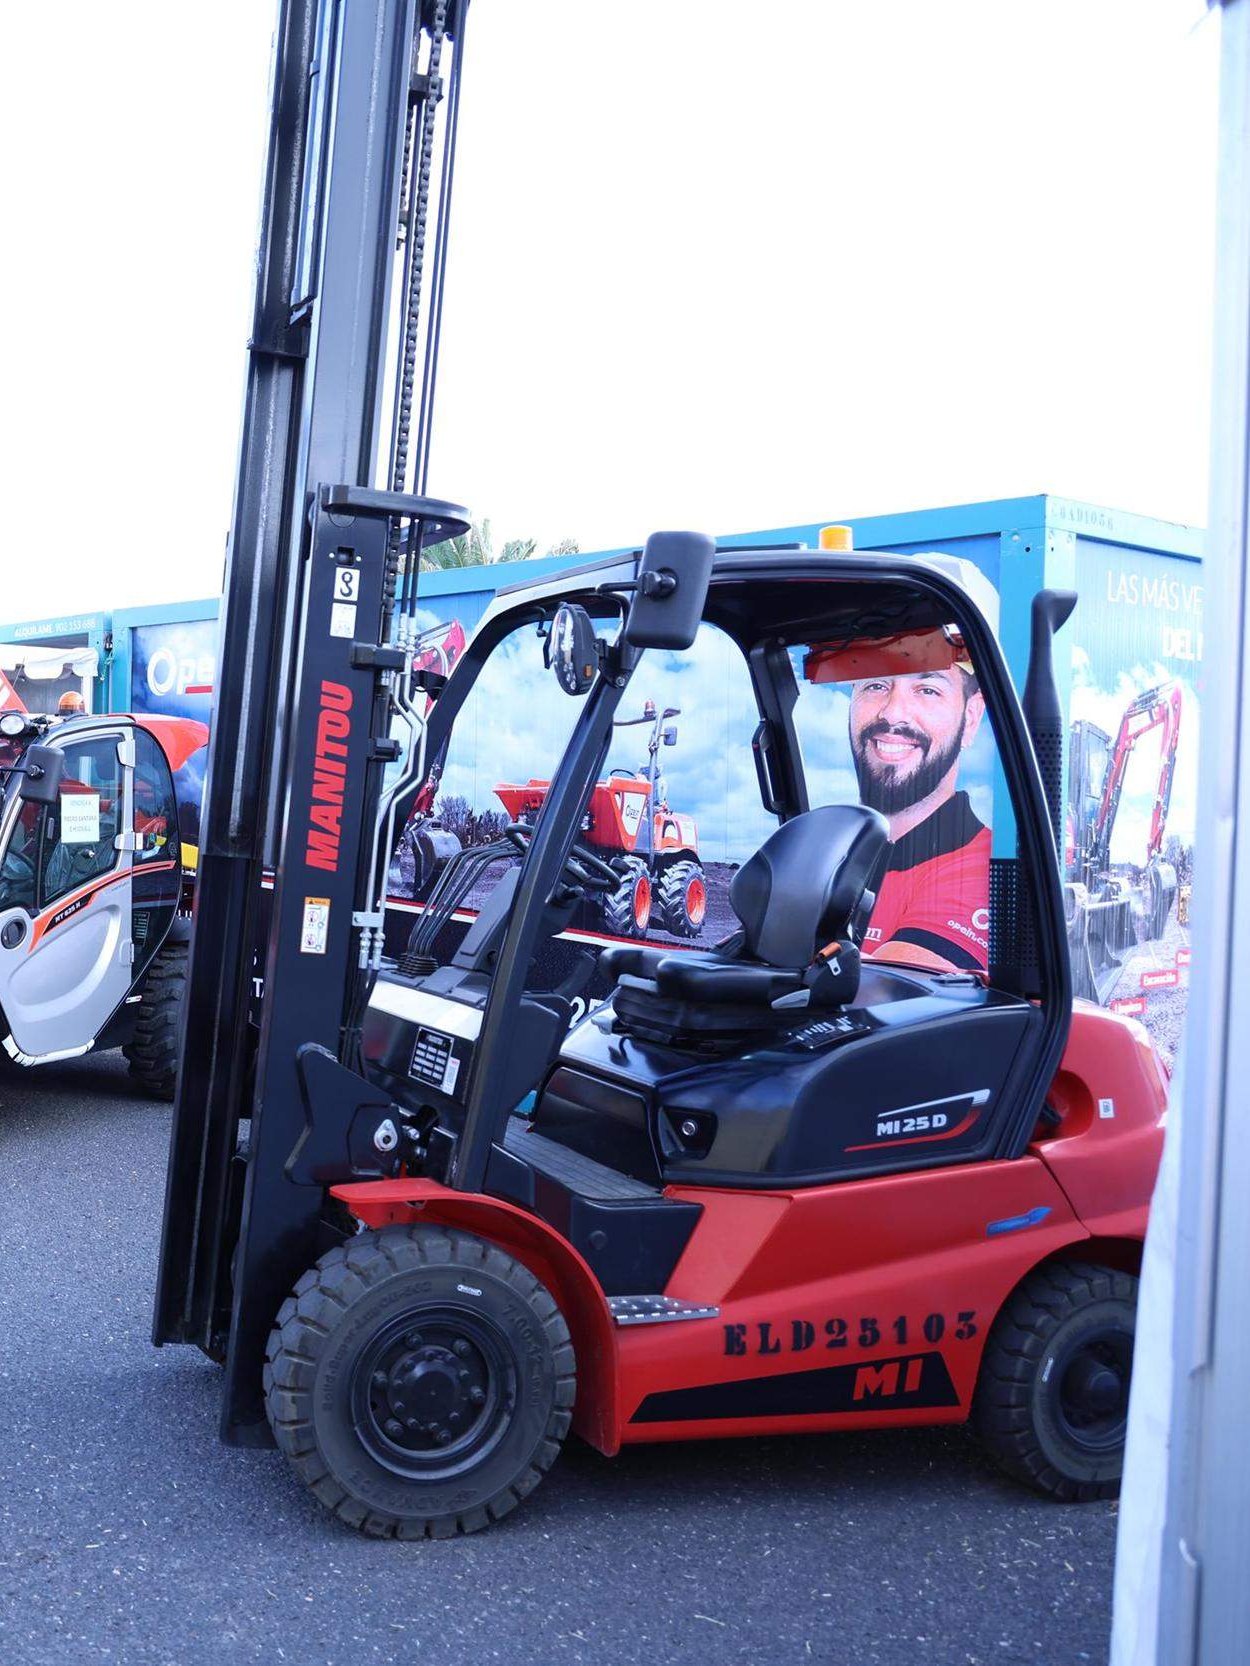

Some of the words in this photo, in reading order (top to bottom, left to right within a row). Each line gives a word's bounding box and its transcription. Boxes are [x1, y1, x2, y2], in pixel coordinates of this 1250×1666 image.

[1107, 570, 1138, 606] LAS
[1141, 573, 1180, 612] MÁS
[1162, 625, 1195, 660] DEL
[147, 648, 215, 696] Ope
[305, 680, 354, 872] MANITOU
[947, 920, 989, 948] opein.co
[724, 1311, 978, 1356] ELD25103
[853, 1357, 924, 1400] MI
